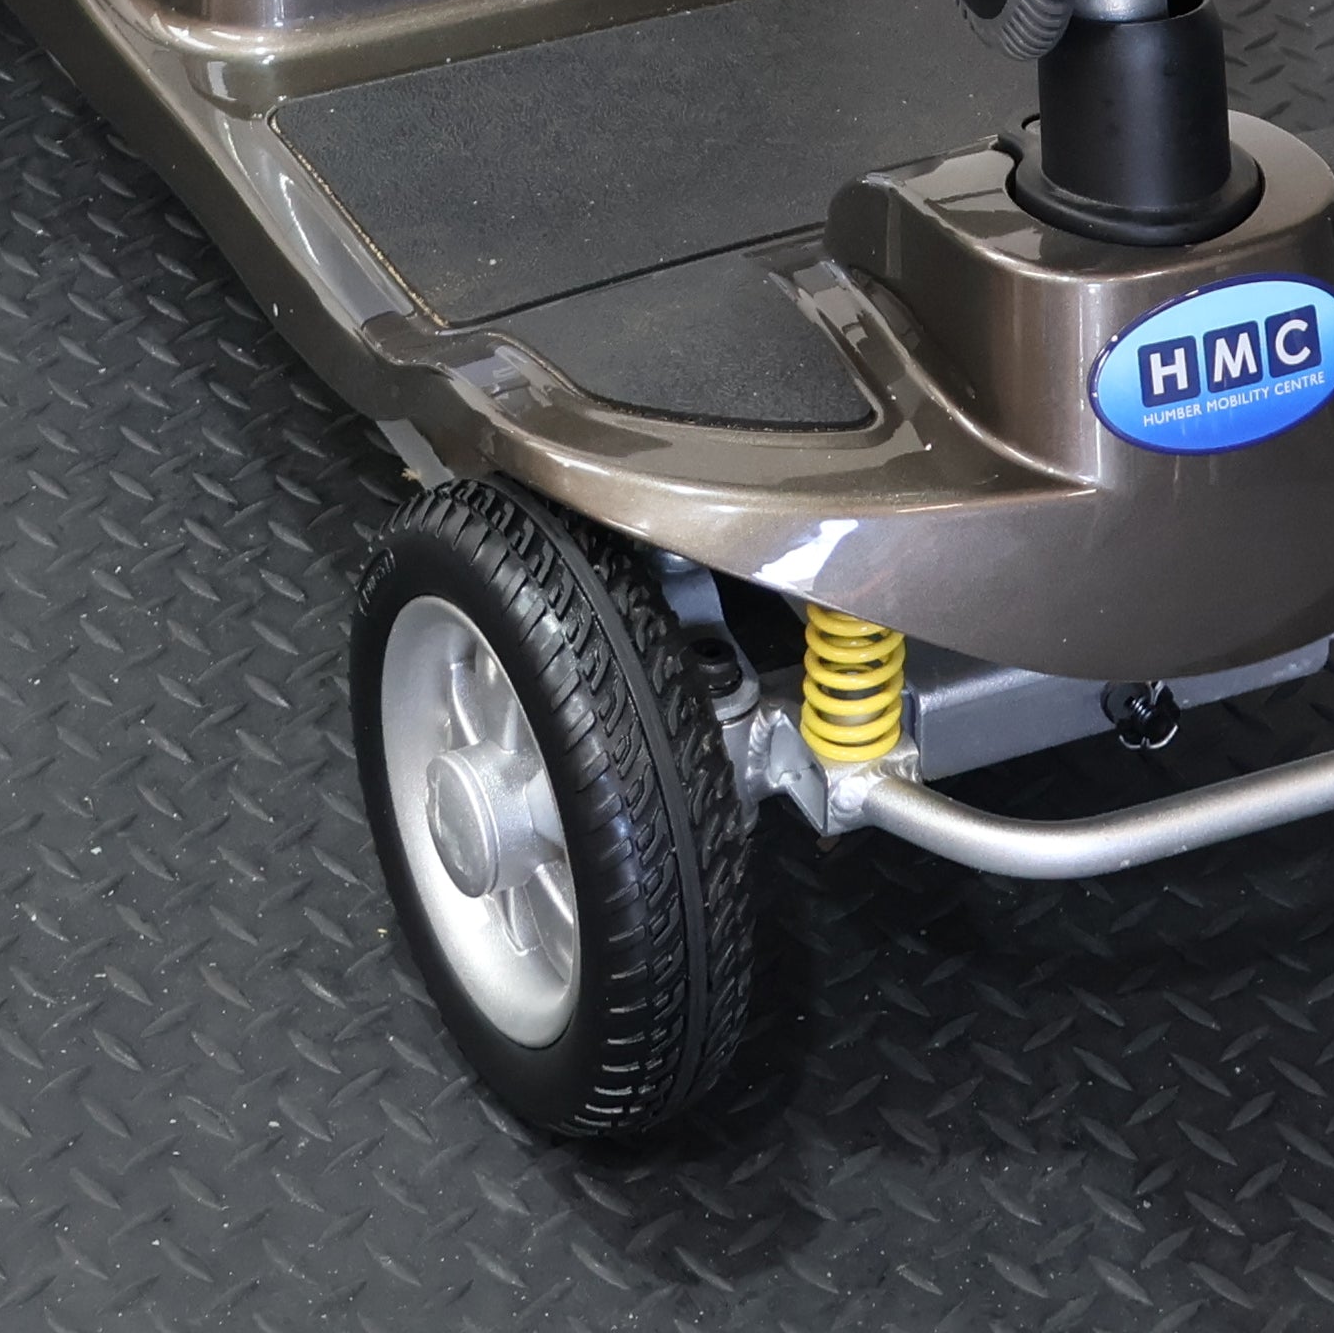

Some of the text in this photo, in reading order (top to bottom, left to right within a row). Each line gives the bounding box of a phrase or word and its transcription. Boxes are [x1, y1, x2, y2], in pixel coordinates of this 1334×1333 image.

[1149, 319, 1312, 395] HMC
[1143, 371, 1325, 427] HUMBER MOBILITY CENTRE
